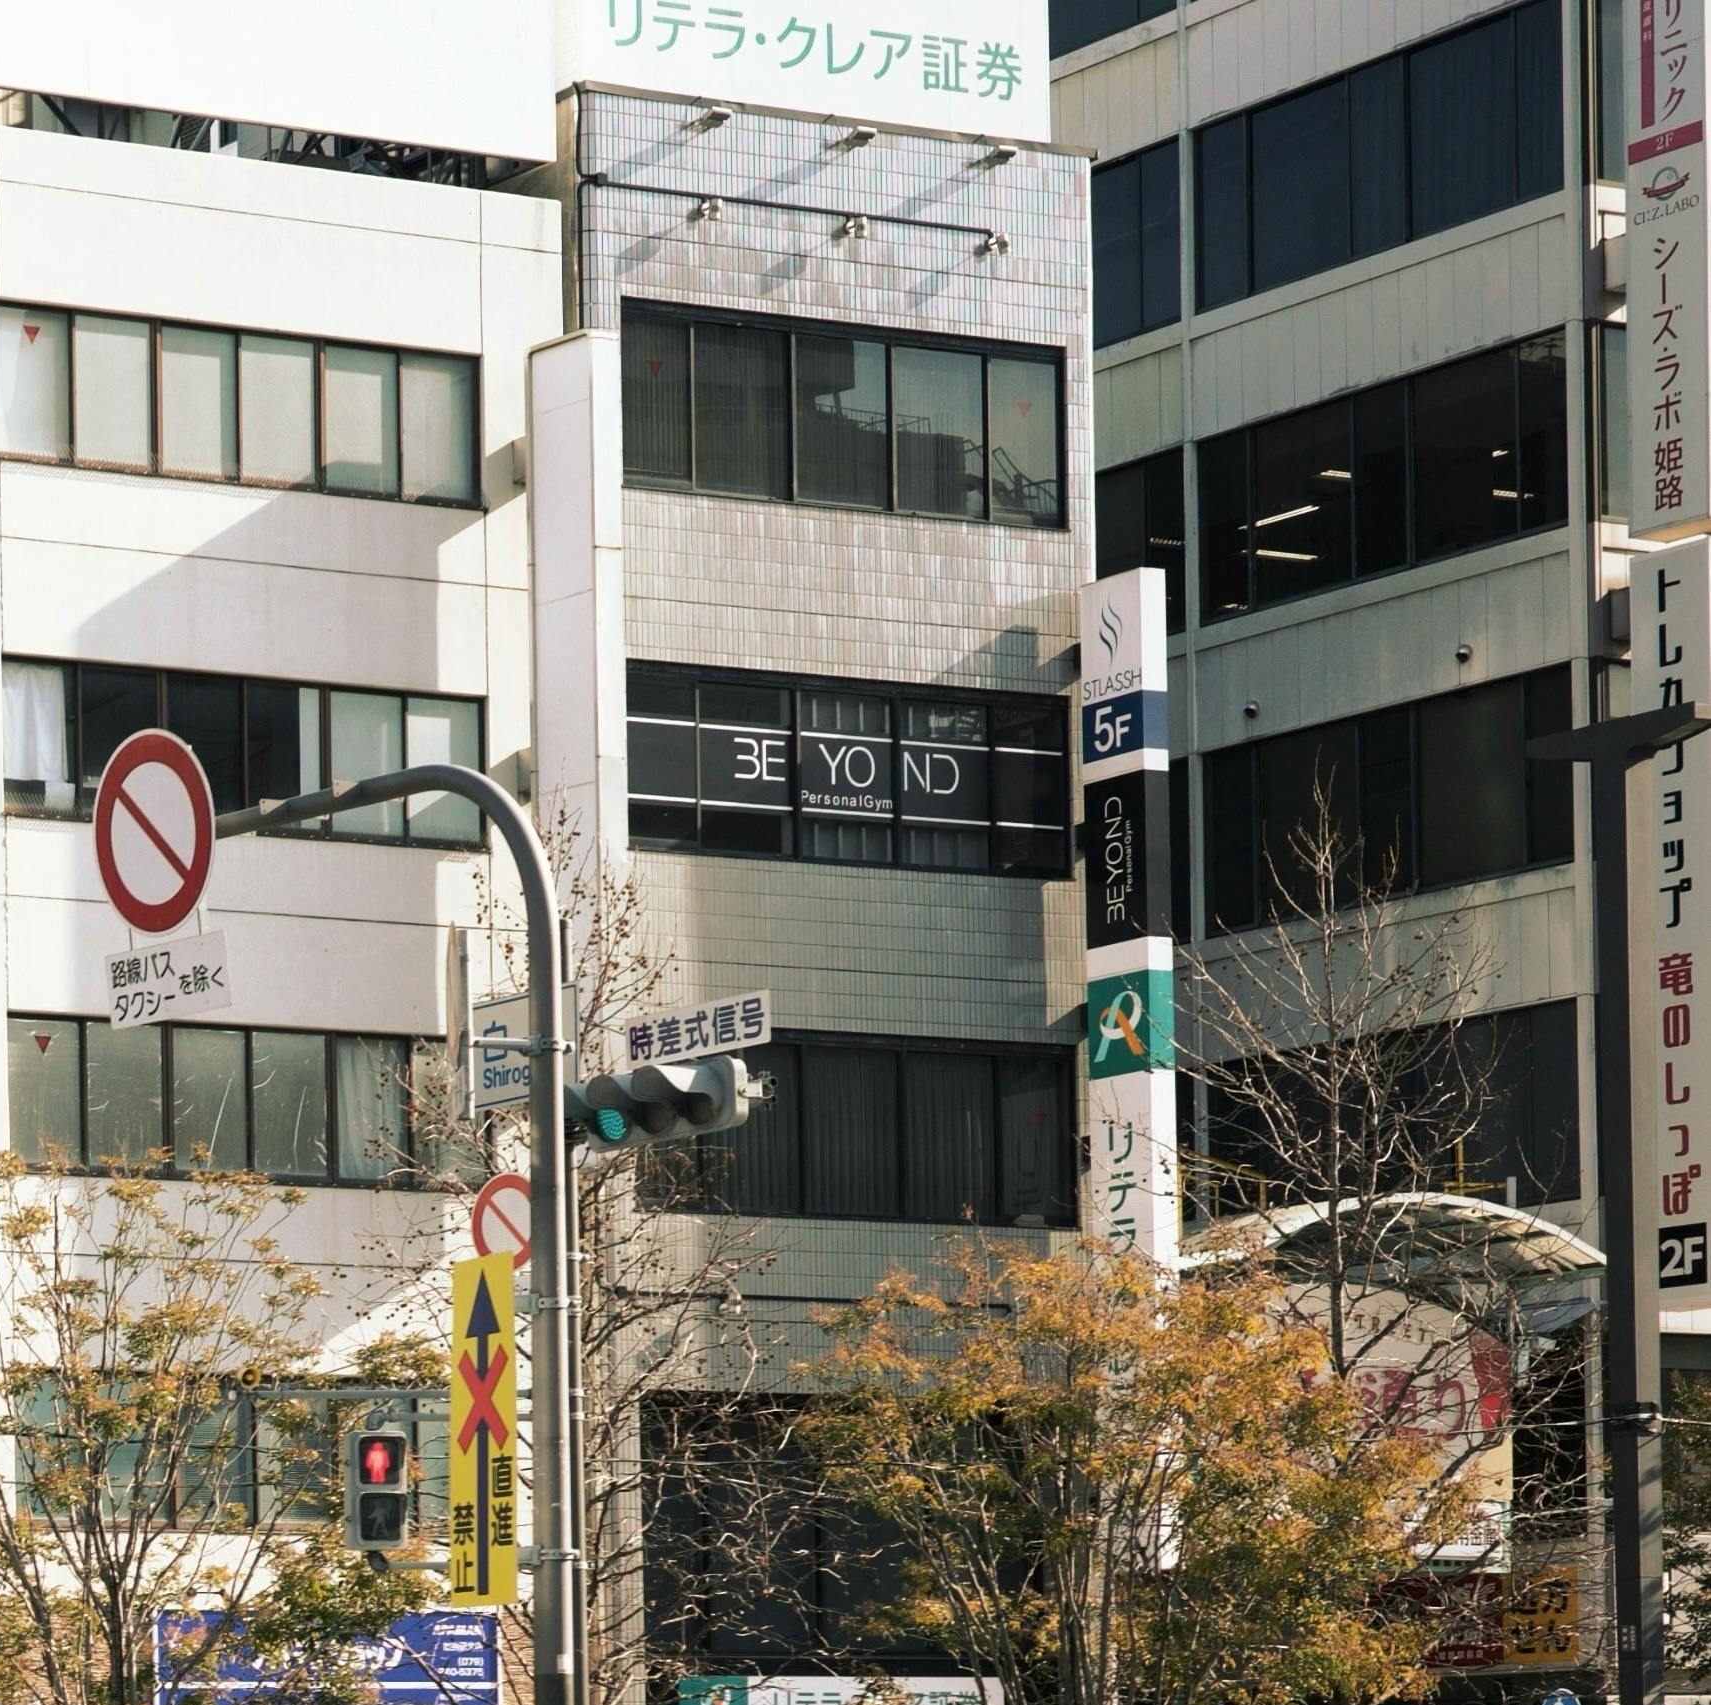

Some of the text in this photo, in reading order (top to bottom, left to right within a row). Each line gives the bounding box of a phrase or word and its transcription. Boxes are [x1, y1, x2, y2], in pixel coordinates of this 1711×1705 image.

[1655, 132, 1674, 151] 2F
[1093, 705, 1132, 753] 5F
[110, 951, 226, 995] 路線バス を除く
[114, 991, 177, 1021] タクシー
[629, 997, 765, 1061] 時差式信号
[483, 1064, 531, 1090] Shirog
[1657, 952, 1702, 1217] 竜のしっぽ
[1659, 1233, 1704, 1278] 2F
[490, 1455, 514, 1547] 直進
[452, 1503, 475, 1596] 禁止
